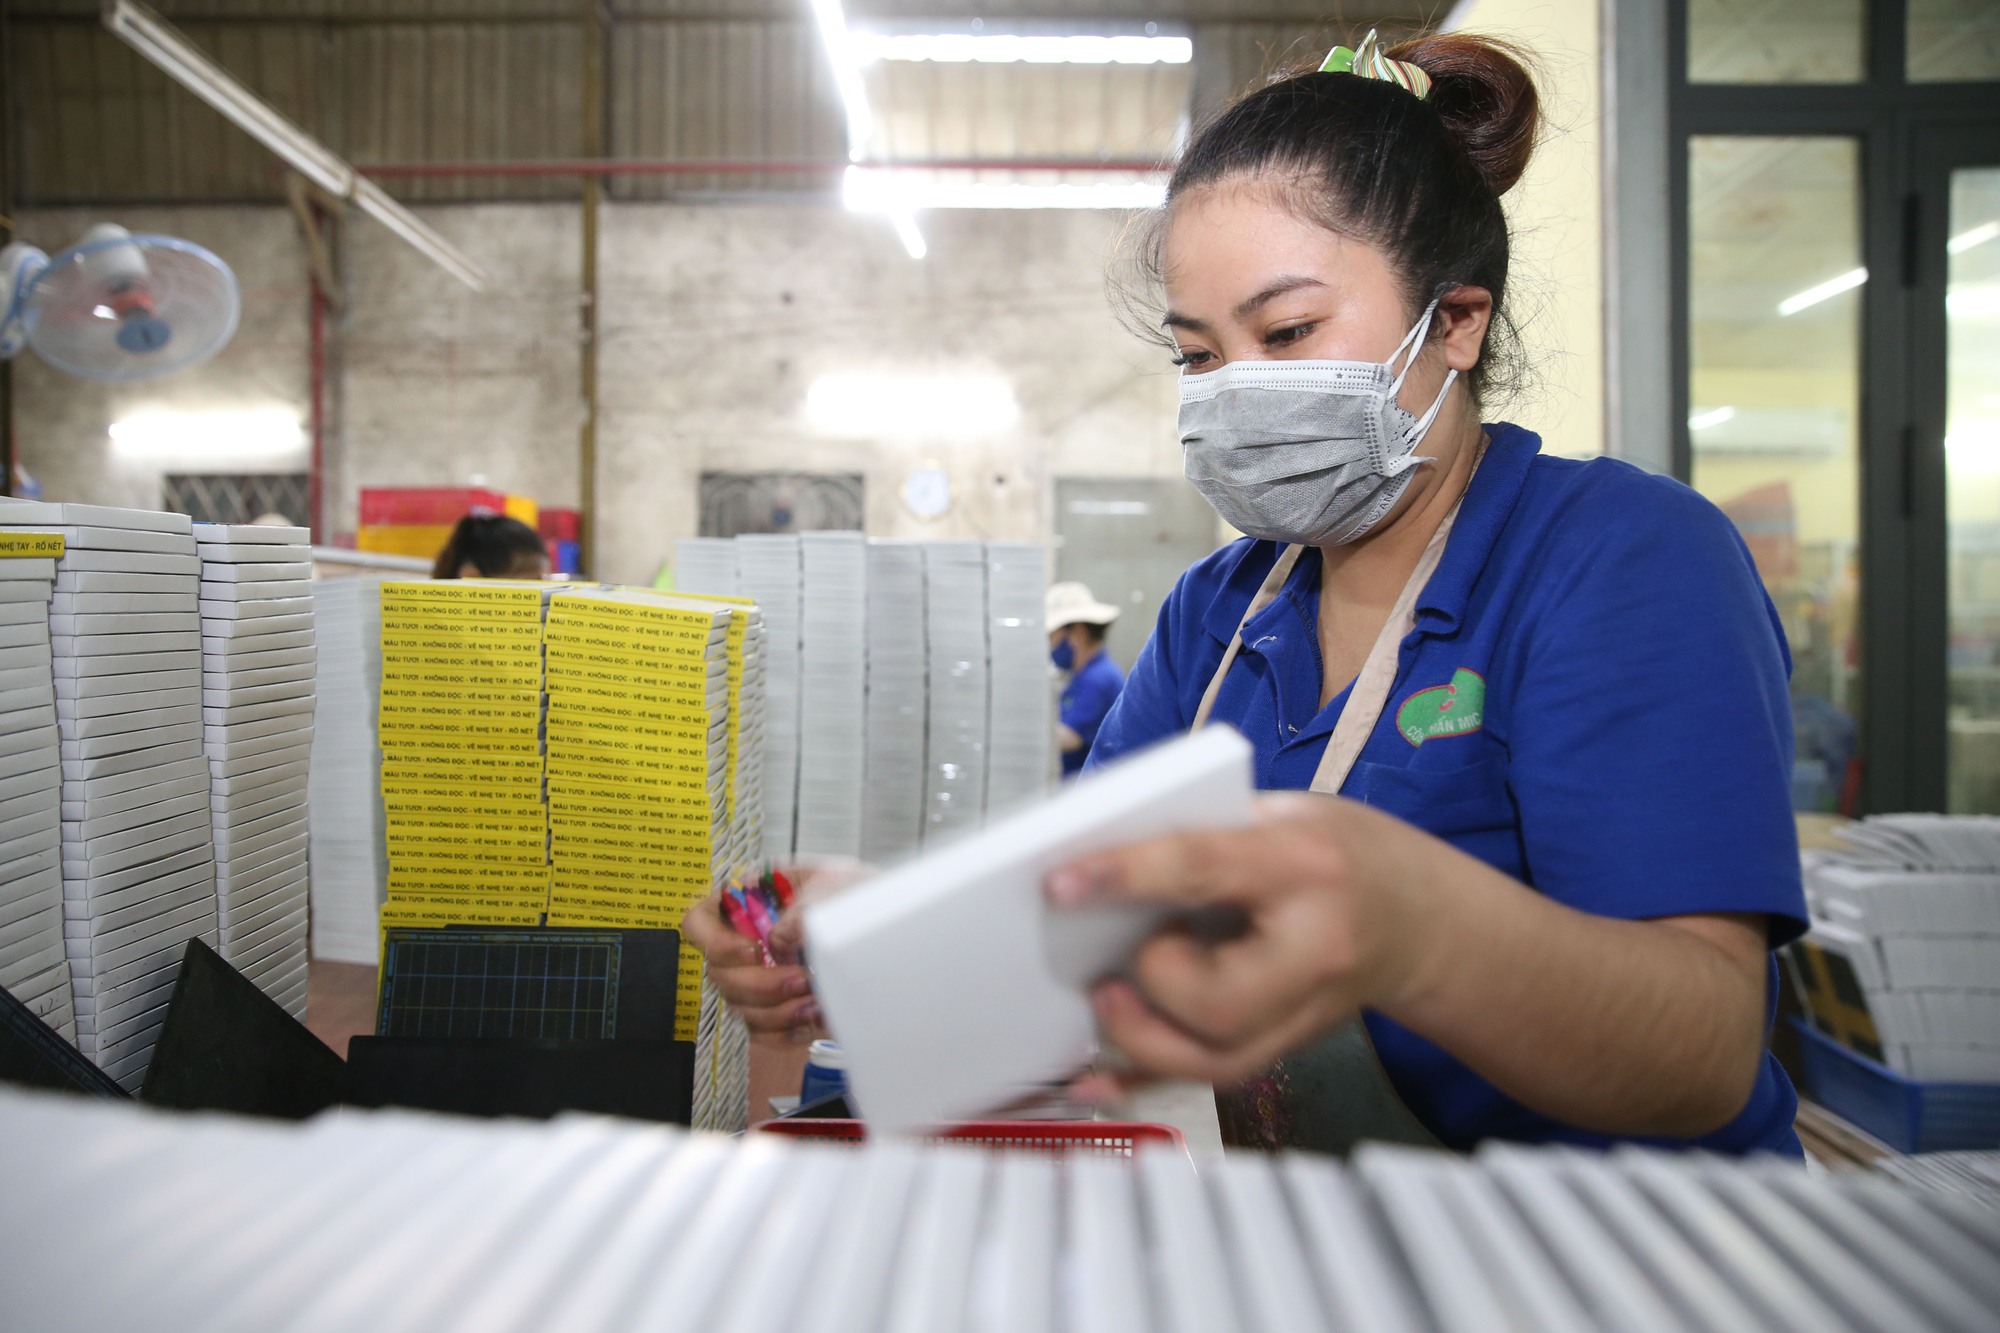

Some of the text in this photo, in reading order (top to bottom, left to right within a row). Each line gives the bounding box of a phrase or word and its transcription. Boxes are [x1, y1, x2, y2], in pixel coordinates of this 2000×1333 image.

[17, 542, 30, 550] TAY
[48, 541, 62, 550] NÉT
[666, 613, 678, 621] TAY
[1458, 712, 1481, 729] MIC
